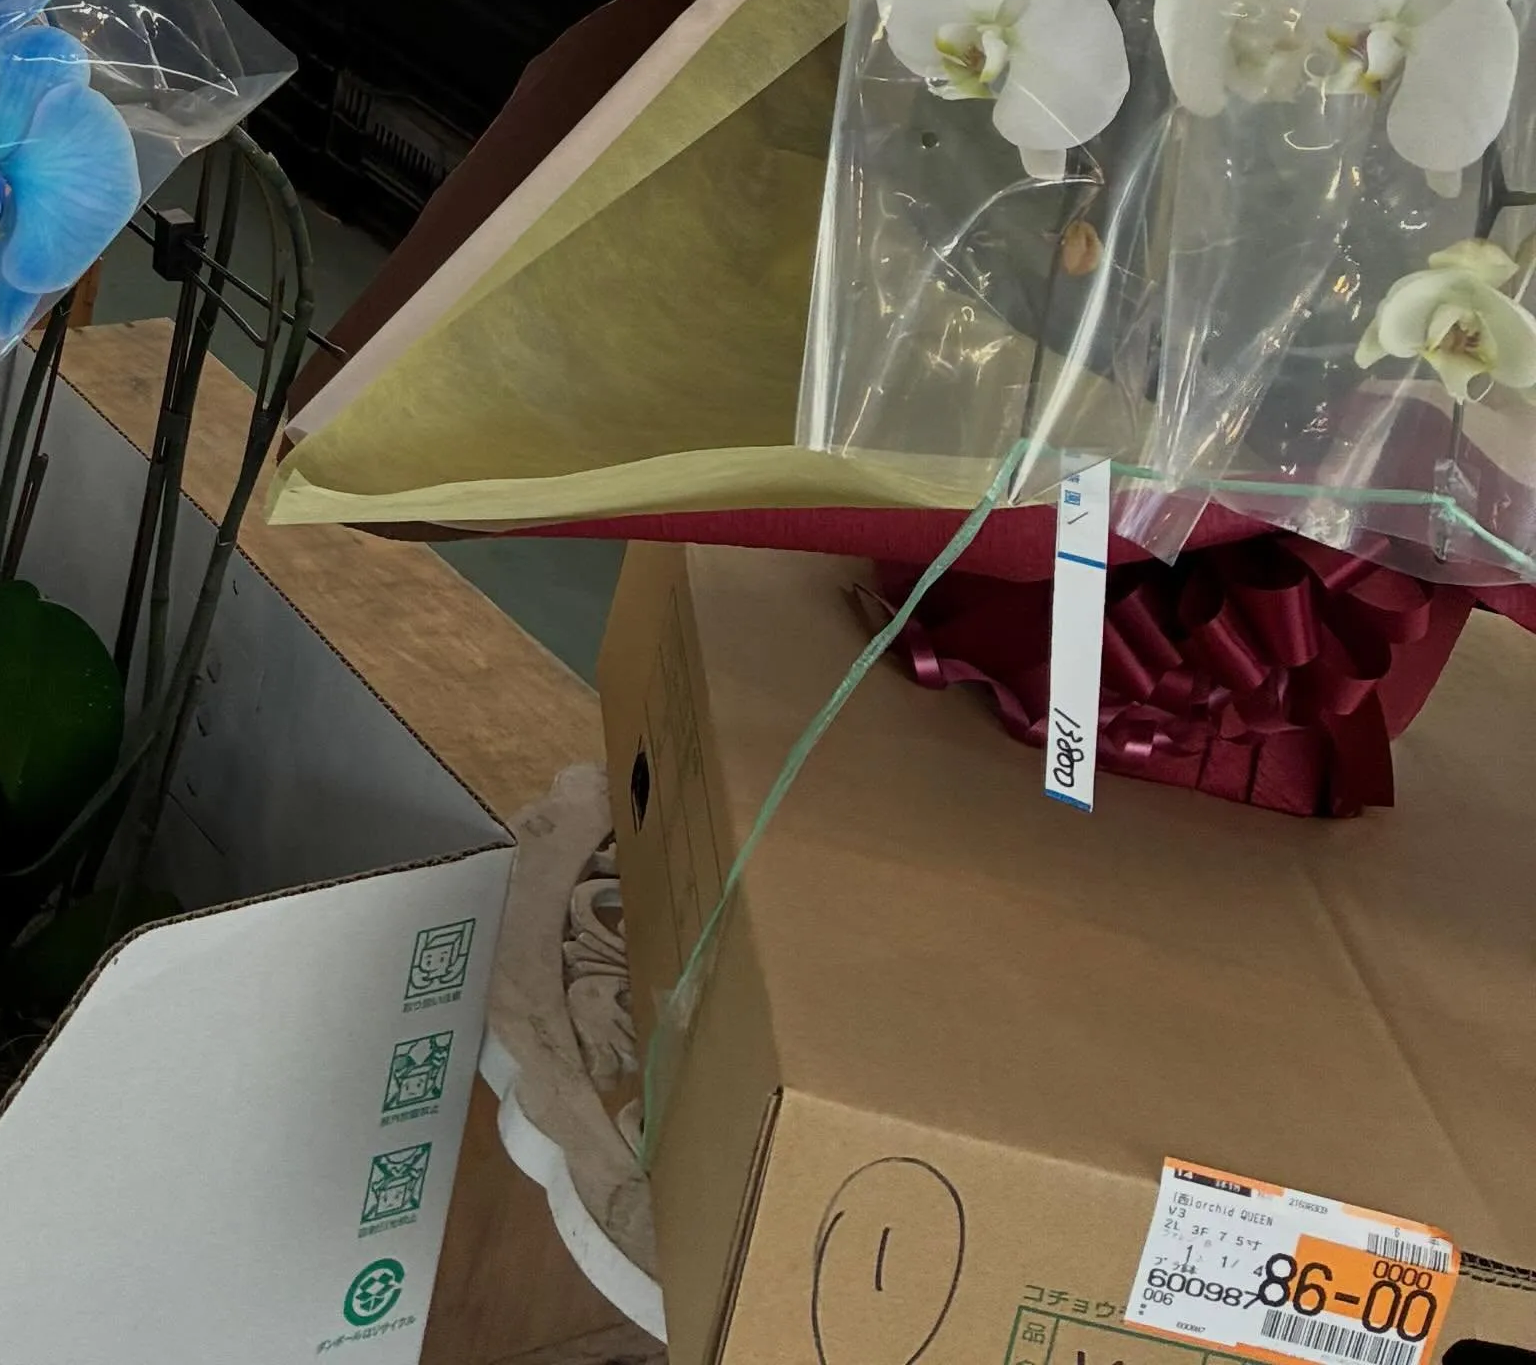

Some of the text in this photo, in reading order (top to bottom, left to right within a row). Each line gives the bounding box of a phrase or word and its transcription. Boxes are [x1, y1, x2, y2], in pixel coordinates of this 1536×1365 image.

[1168, 1205, 1187, 1219] V3
[1240, 1206, 1274, 1227] QUEEN
[1191, 1224, 1210, 1236] 3F
[1372, 1259, 1433, 1291] 0000
[1143, 1287, 1175, 1306] 006
[1147, 1267, 1264, 1310] 600987
[1258, 1252, 1438, 1343] 86-00
